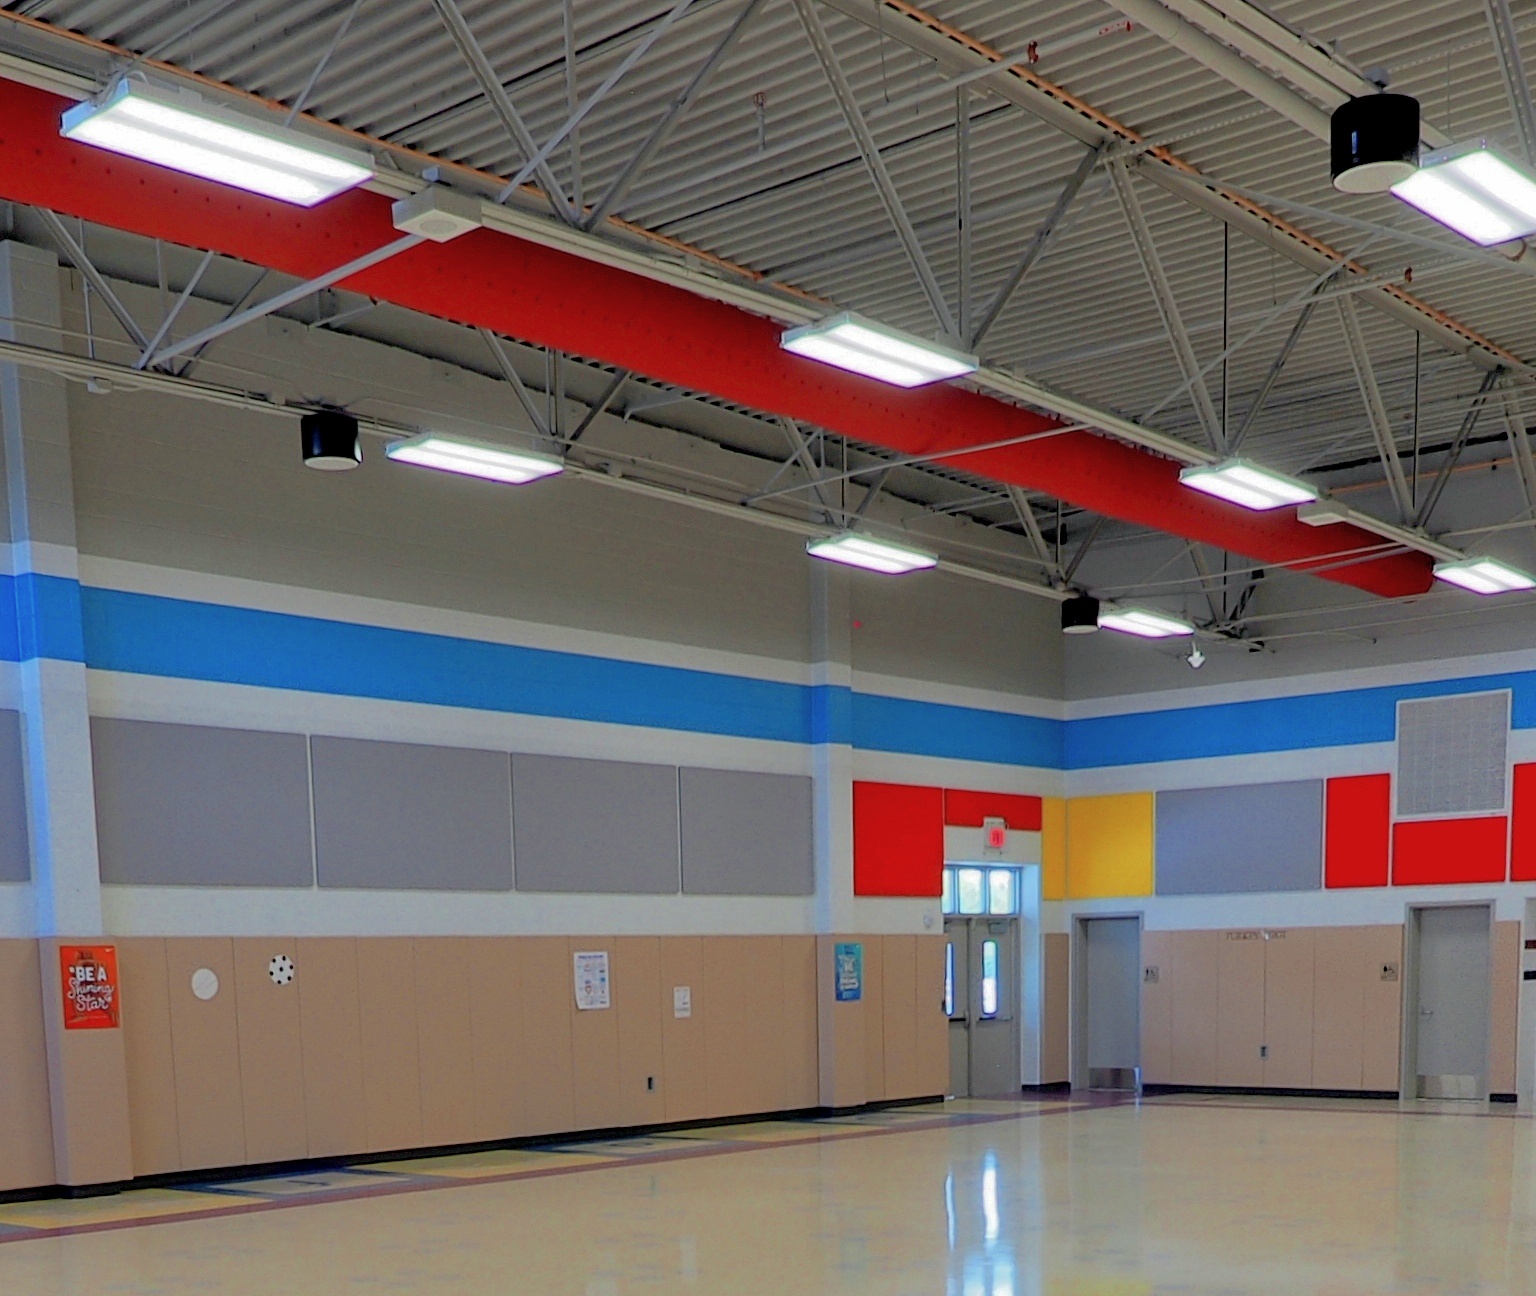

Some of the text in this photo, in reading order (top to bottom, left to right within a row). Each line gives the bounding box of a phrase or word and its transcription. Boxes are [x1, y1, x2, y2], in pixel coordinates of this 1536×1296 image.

[76, 966, 107, 981] BE A
[67, 977, 114, 1002] Shining
[77, 995, 108, 1011] Star
